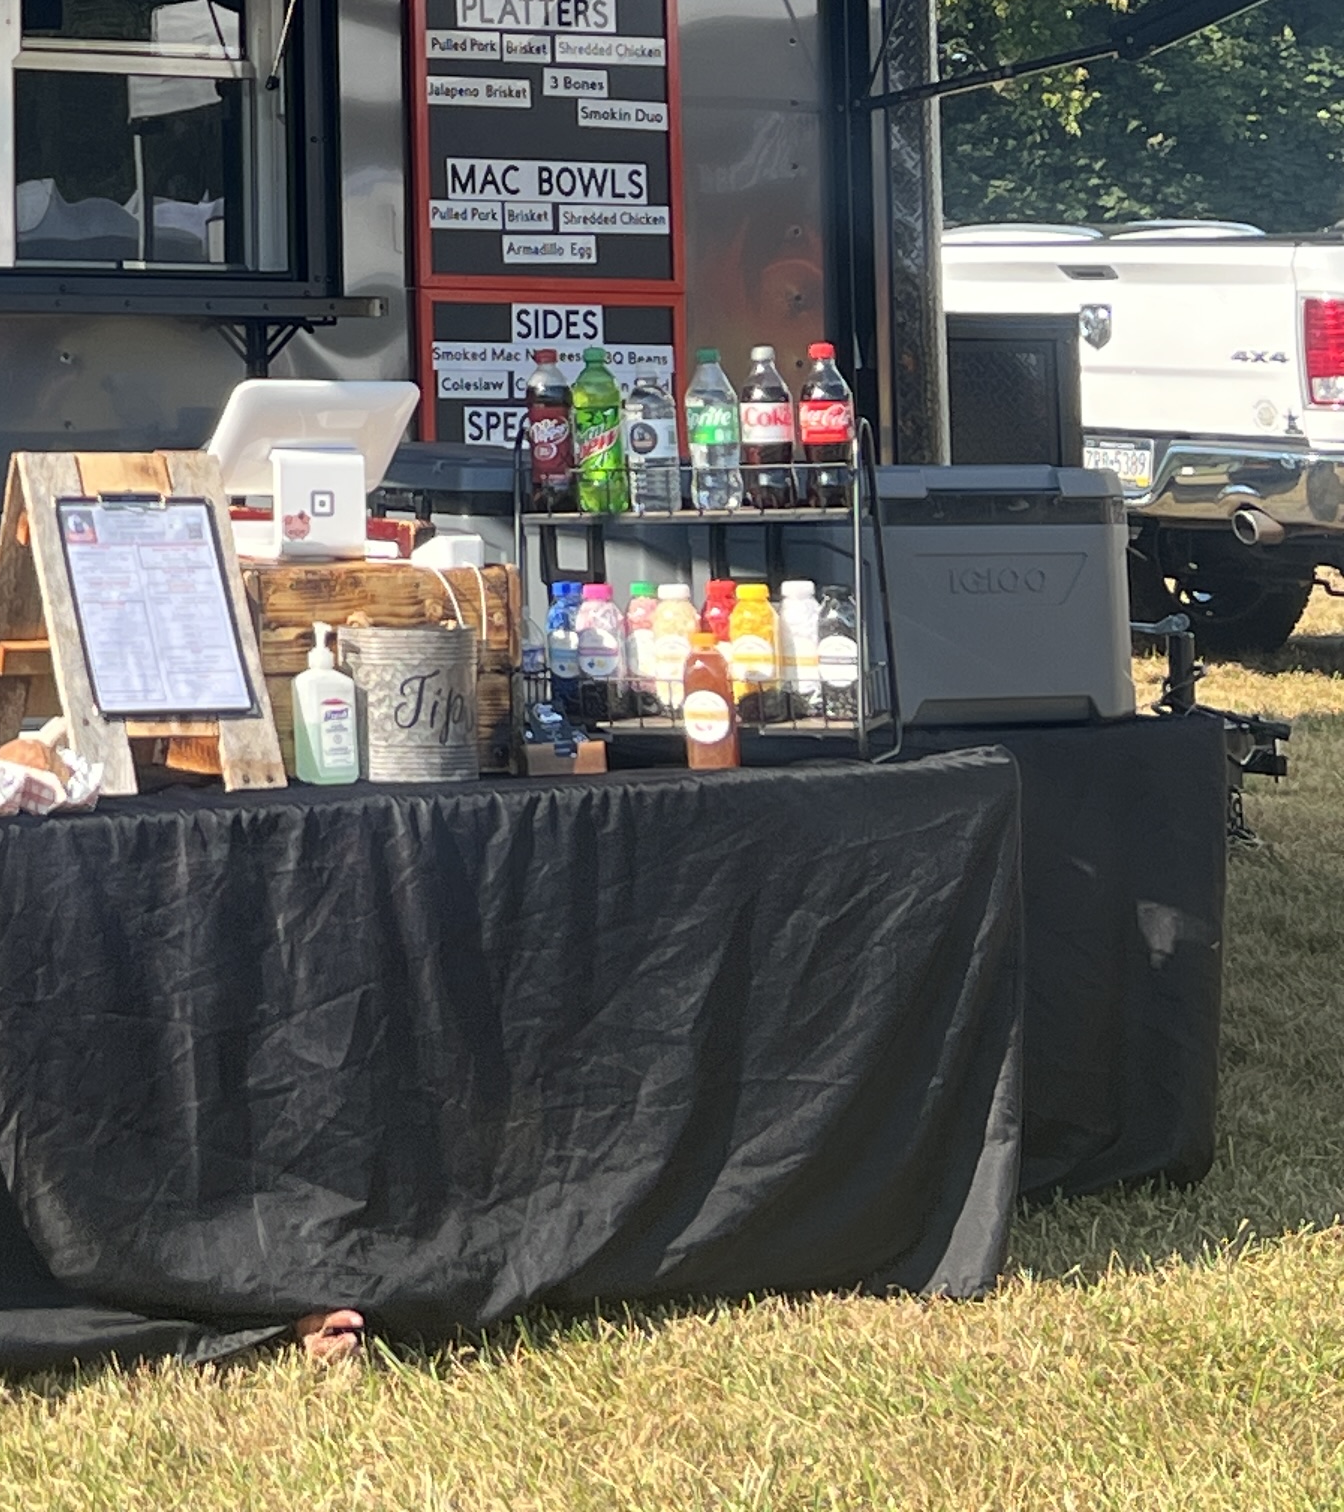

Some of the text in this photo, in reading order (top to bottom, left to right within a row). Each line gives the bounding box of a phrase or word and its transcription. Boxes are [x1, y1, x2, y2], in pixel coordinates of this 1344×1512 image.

[432, 37, 497, 52] Pulled Pork
[506, 40, 548, 55] Brisket
[559, 42, 661, 57] Shredded Chicken
[428, 83, 527, 99] Jalapeno Brisket
[550, 76, 605, 91] 3 Bones
[581, 106, 664, 123] Smokin Duo
[450, 163, 644, 200] MAC BOWLS
[432, 207, 498, 221] Pulled Pork
[507, 209, 548, 223] Brisket
[563, 211, 666, 226] Shredded Chicken
[507, 242, 592, 259] Armadillo Egg
[516, 309, 599, 340] SIDES
[433, 347, 486, 361] Smoked
[492, 348, 521, 361] Mac
[628, 352, 668, 365] Beans
[441, 377, 505, 392] Coleslaw
[468, 410, 519, 442] SPE
[949, 566, 1046, 594] IGLOO
